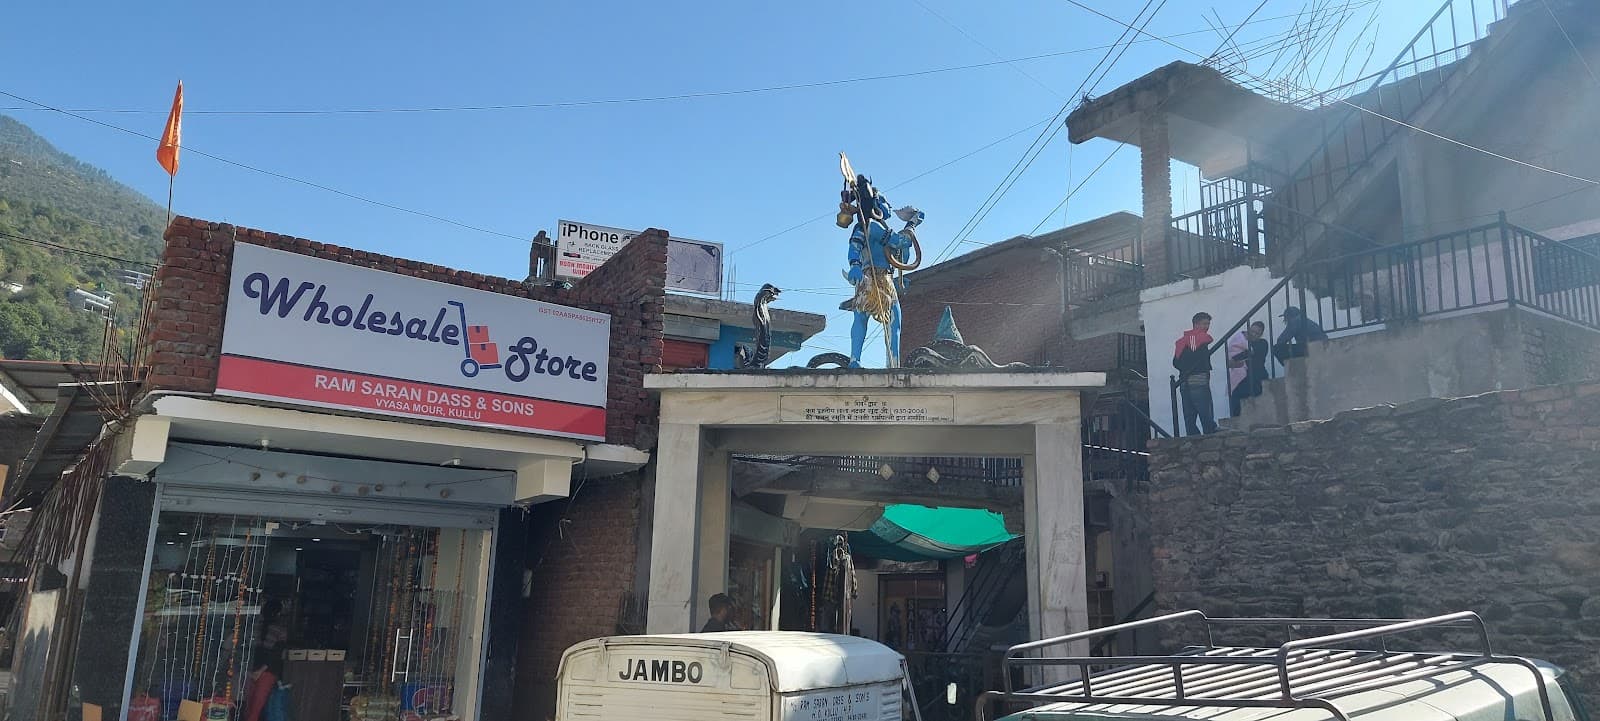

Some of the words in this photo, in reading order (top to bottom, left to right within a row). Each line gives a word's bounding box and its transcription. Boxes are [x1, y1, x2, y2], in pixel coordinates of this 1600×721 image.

[562, 223, 619, 244] iPhone
[242, 272, 461, 346] Wholesale
[504, 336, 598, 383] Store
[314, 374, 356, 393] RAM
[360, 379, 422, 400] SARAN
[427, 388, 475, 408] DASS
[477, 395, 490, 409] &
[492, 398, 535, 417] SONS
[375, 397, 411, 412] VYASA
[412, 403, 446, 417] MOUR,
[448, 407, 481, 420] KULLU
[618, 658, 703, 684] JAMBO
[800, 700, 810, 710] RAM
[855, 692, 870, 703] SONS
